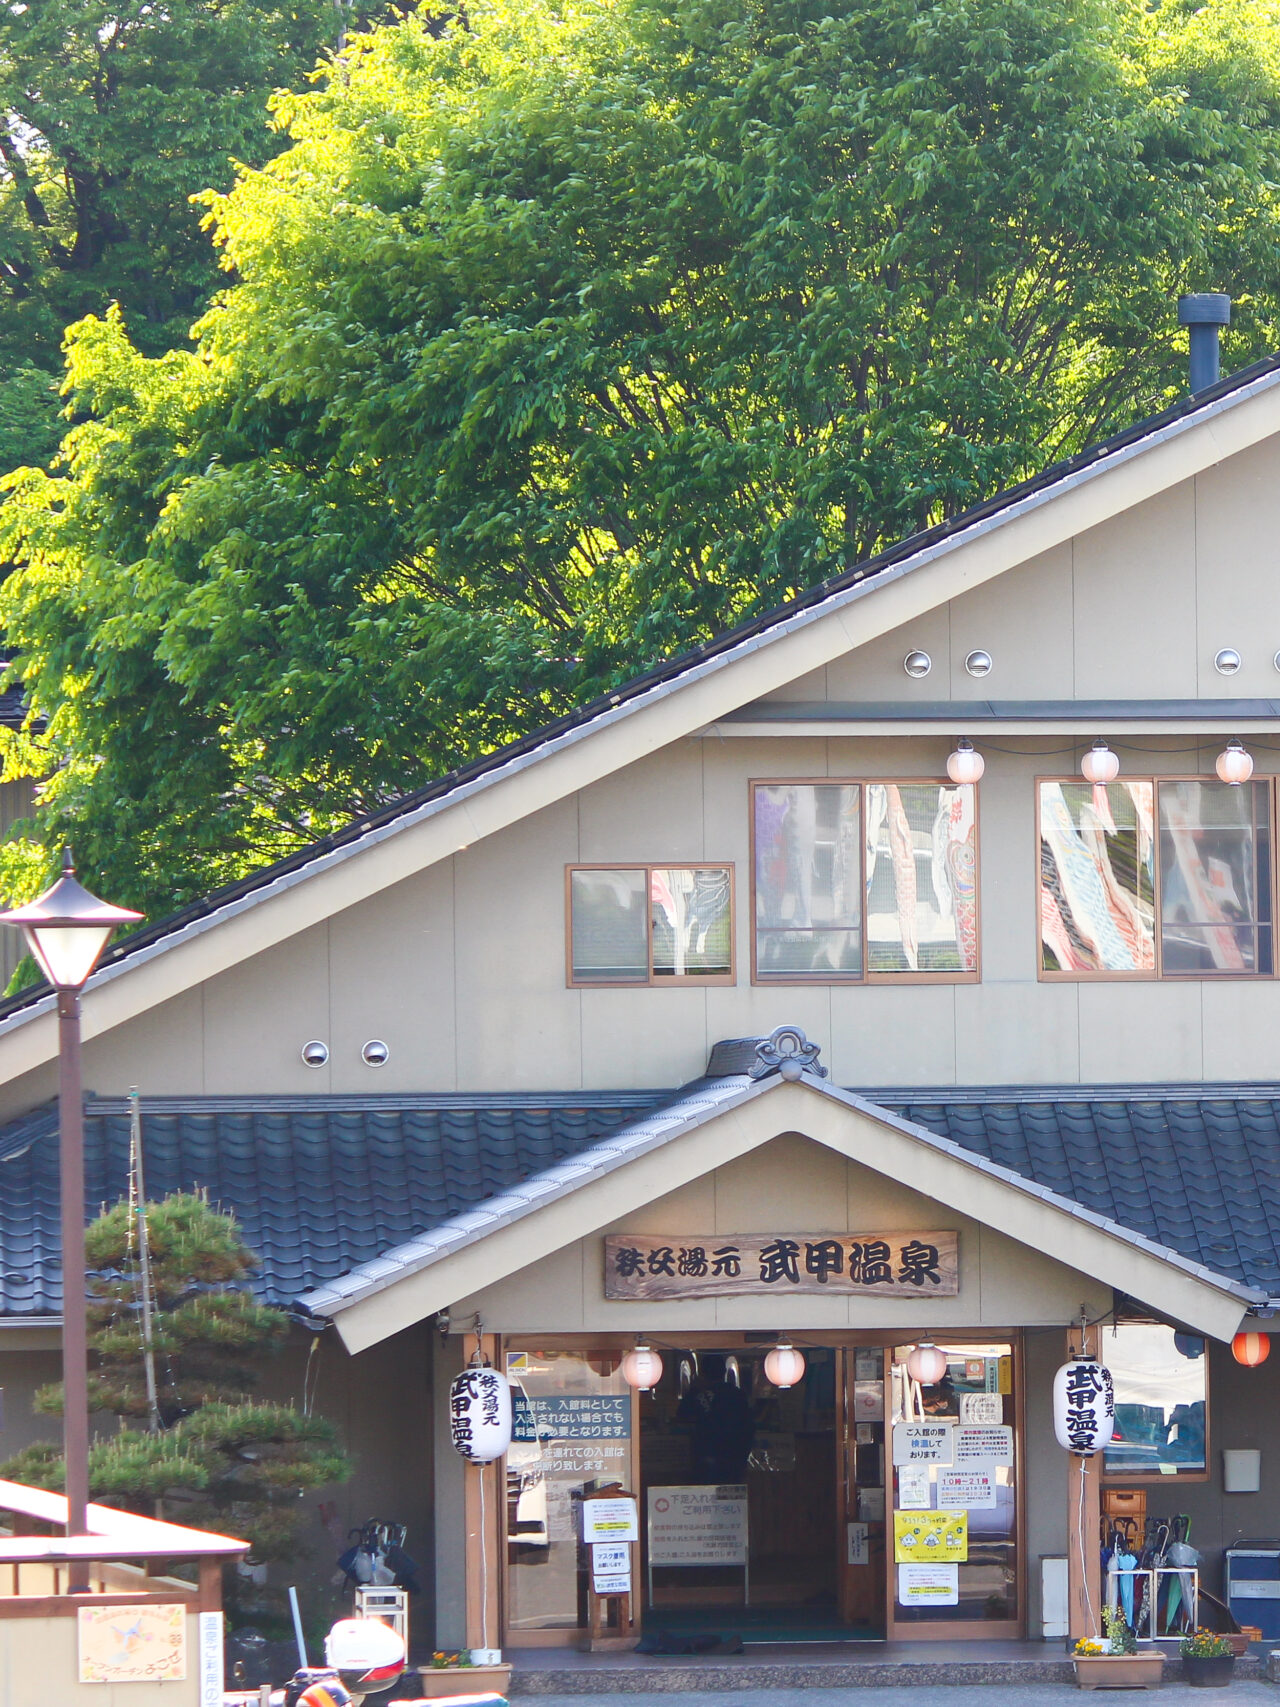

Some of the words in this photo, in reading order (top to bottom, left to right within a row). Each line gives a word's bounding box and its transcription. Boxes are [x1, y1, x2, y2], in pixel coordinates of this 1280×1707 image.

[614, 1246, 742, 1278] 秩父湯元
[758, 1238, 942, 1286] 武甲温泉
[451, 1371, 482, 1460] 武甲温泉
[1065, 1364, 1103, 1451] 武甲温泉
